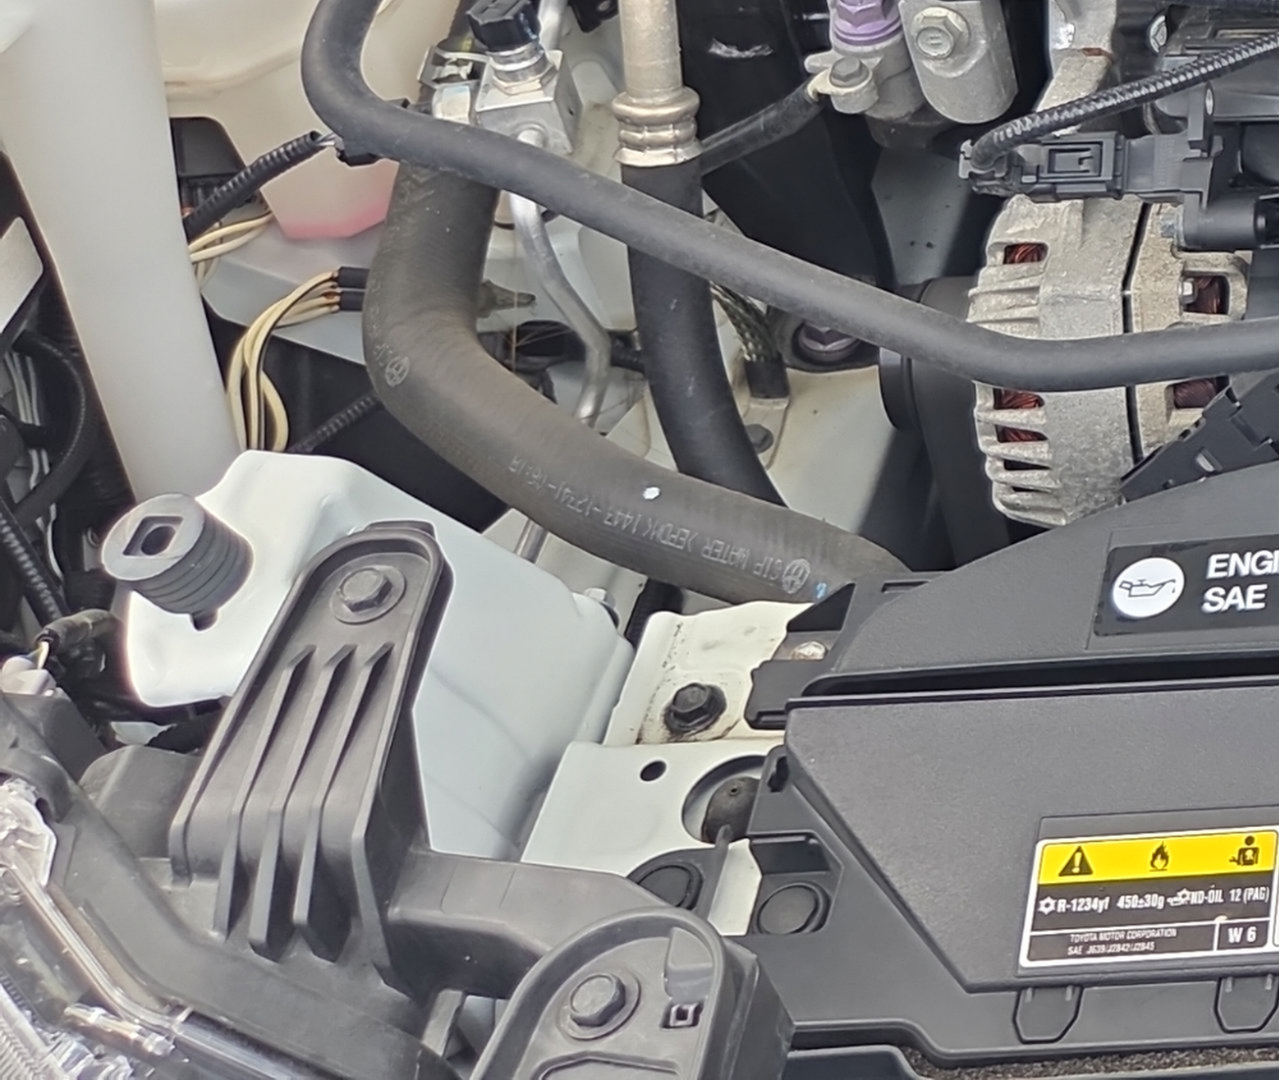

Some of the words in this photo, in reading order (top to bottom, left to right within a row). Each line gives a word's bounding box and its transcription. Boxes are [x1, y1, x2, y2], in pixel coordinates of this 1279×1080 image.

[1201, 583, 1268, 614] SAE
[1056, 896, 1110, 913] R-1234yf
[1229, 888, 1242, 902] 12
[1243, 886, 1270, 903] (PAG)
[1070, 932, 1098, 943] TOYOTA
[1098, 930, 1125, 941] MOTOR
[1126, 928, 1177, 940] CORPORATION
[1227, 928, 1245, 943] W
[1246, 926, 1257, 942] 6
[1067, 945, 1083, 956] SAE
